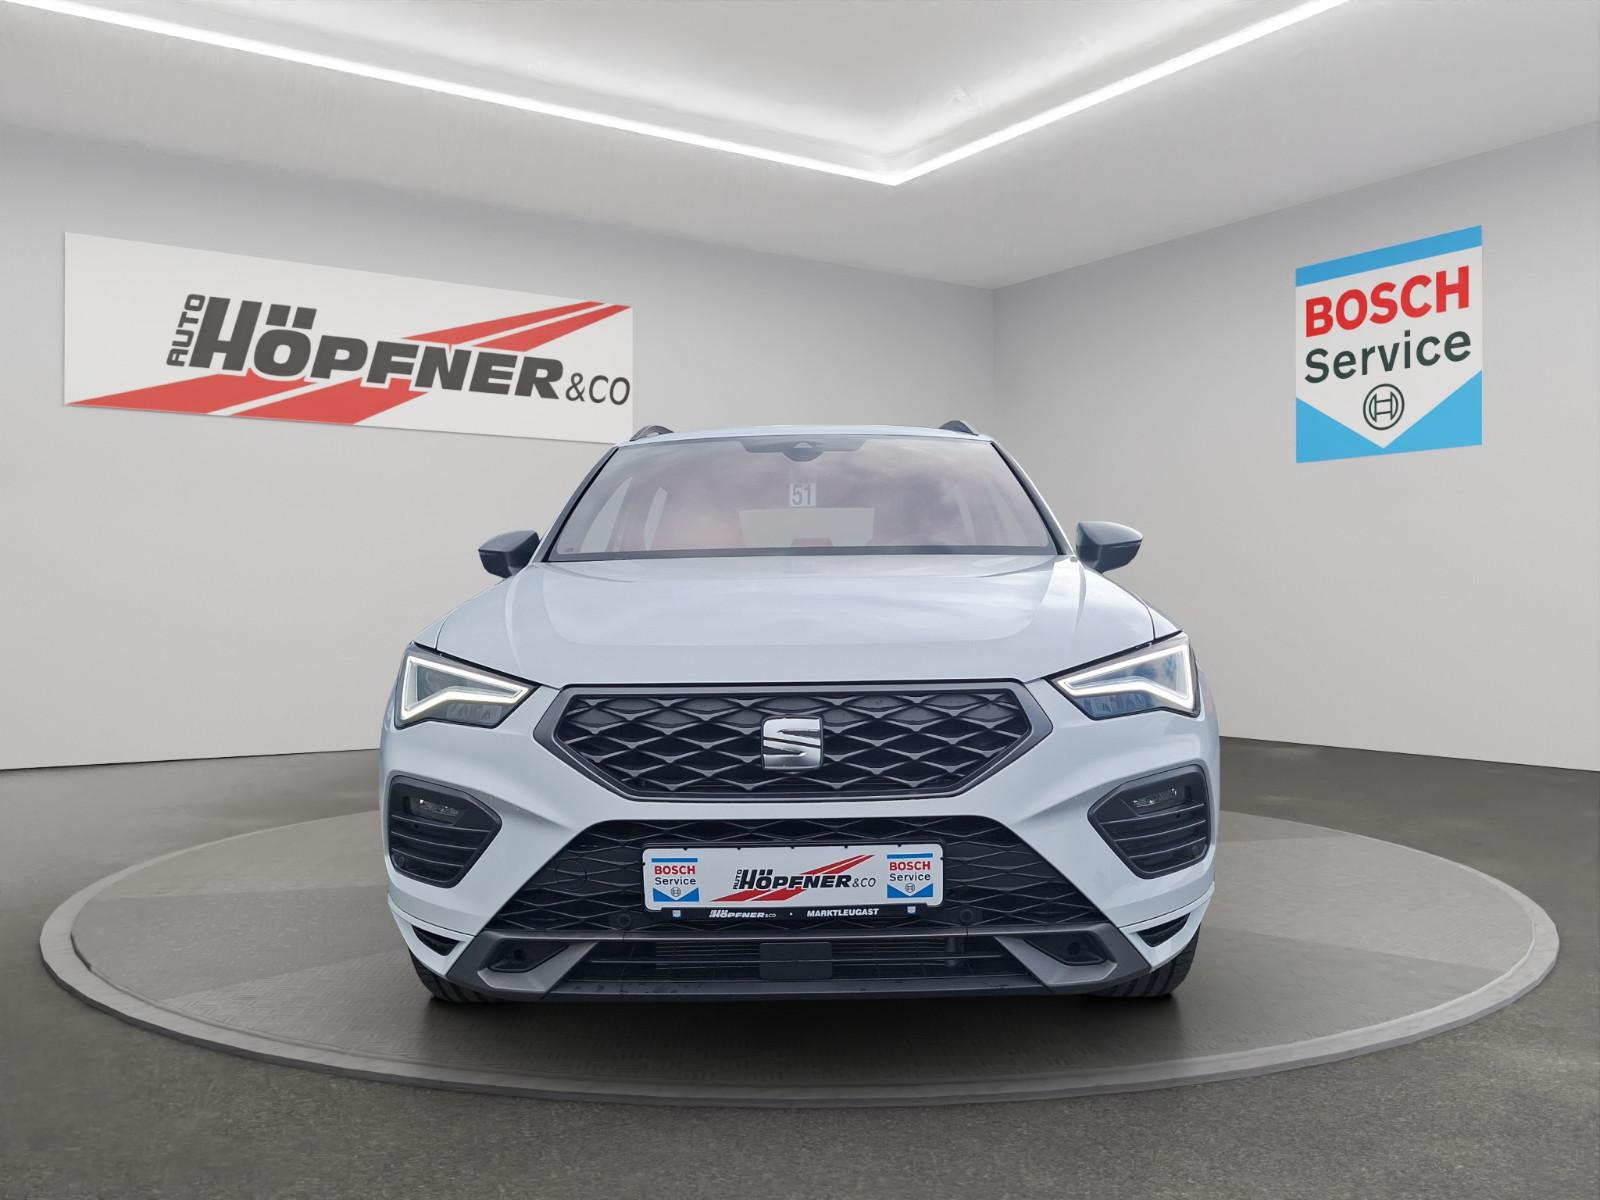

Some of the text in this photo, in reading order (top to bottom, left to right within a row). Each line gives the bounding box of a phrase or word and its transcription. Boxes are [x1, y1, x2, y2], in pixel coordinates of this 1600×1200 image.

[1305, 265, 1469, 338] BOSCH
[166, 293, 206, 367] AUTO
[1304, 329, 1472, 384] Service
[654, 865, 696, 874] BOSCH
[889, 861, 931, 870] BOSCH
[655, 876, 696, 885] Service
[889, 872, 931, 881] Service
[806, 908, 880, 918] MARKTLEUGAST
